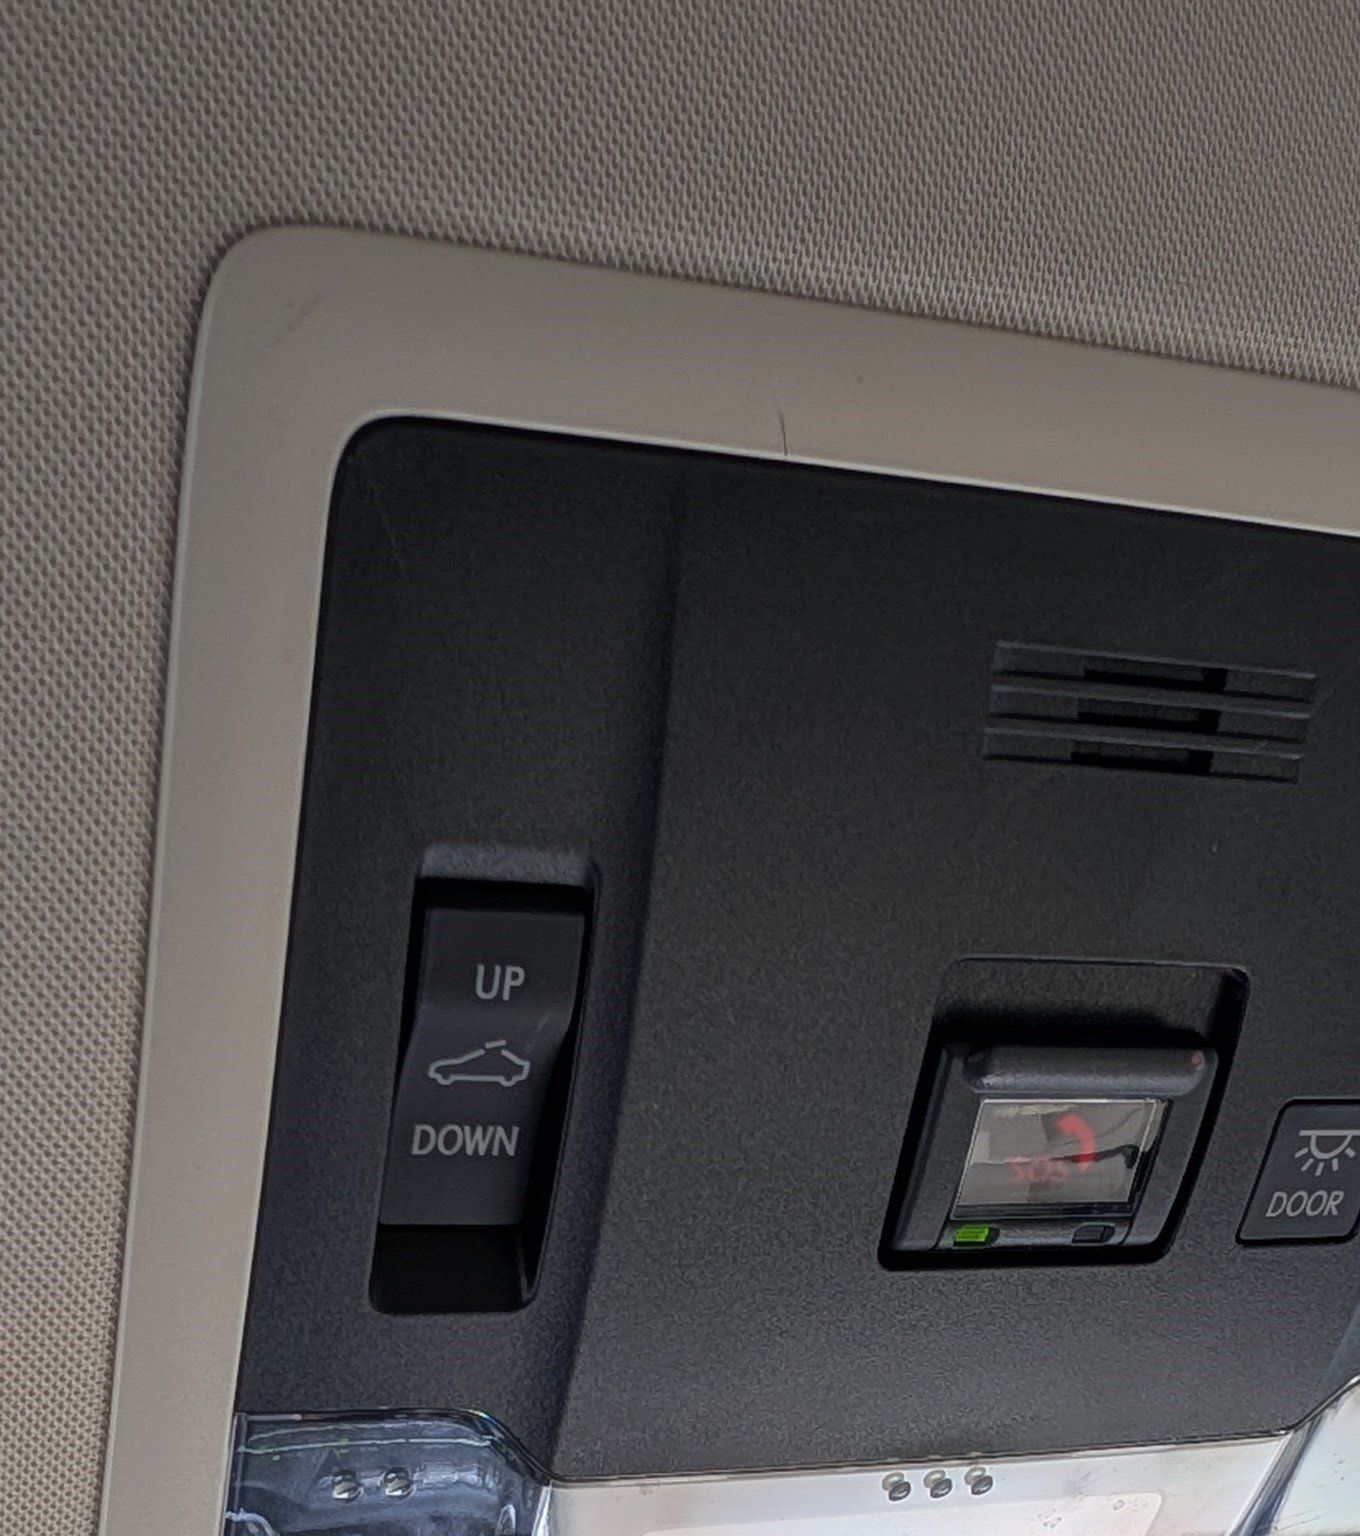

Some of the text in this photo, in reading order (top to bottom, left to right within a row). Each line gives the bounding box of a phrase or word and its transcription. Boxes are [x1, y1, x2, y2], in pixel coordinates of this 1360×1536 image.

[474, 963, 525, 1001] UP
[410, 1123, 520, 1157] DOWN
[1265, 1190, 1345, 1218] DOOR
